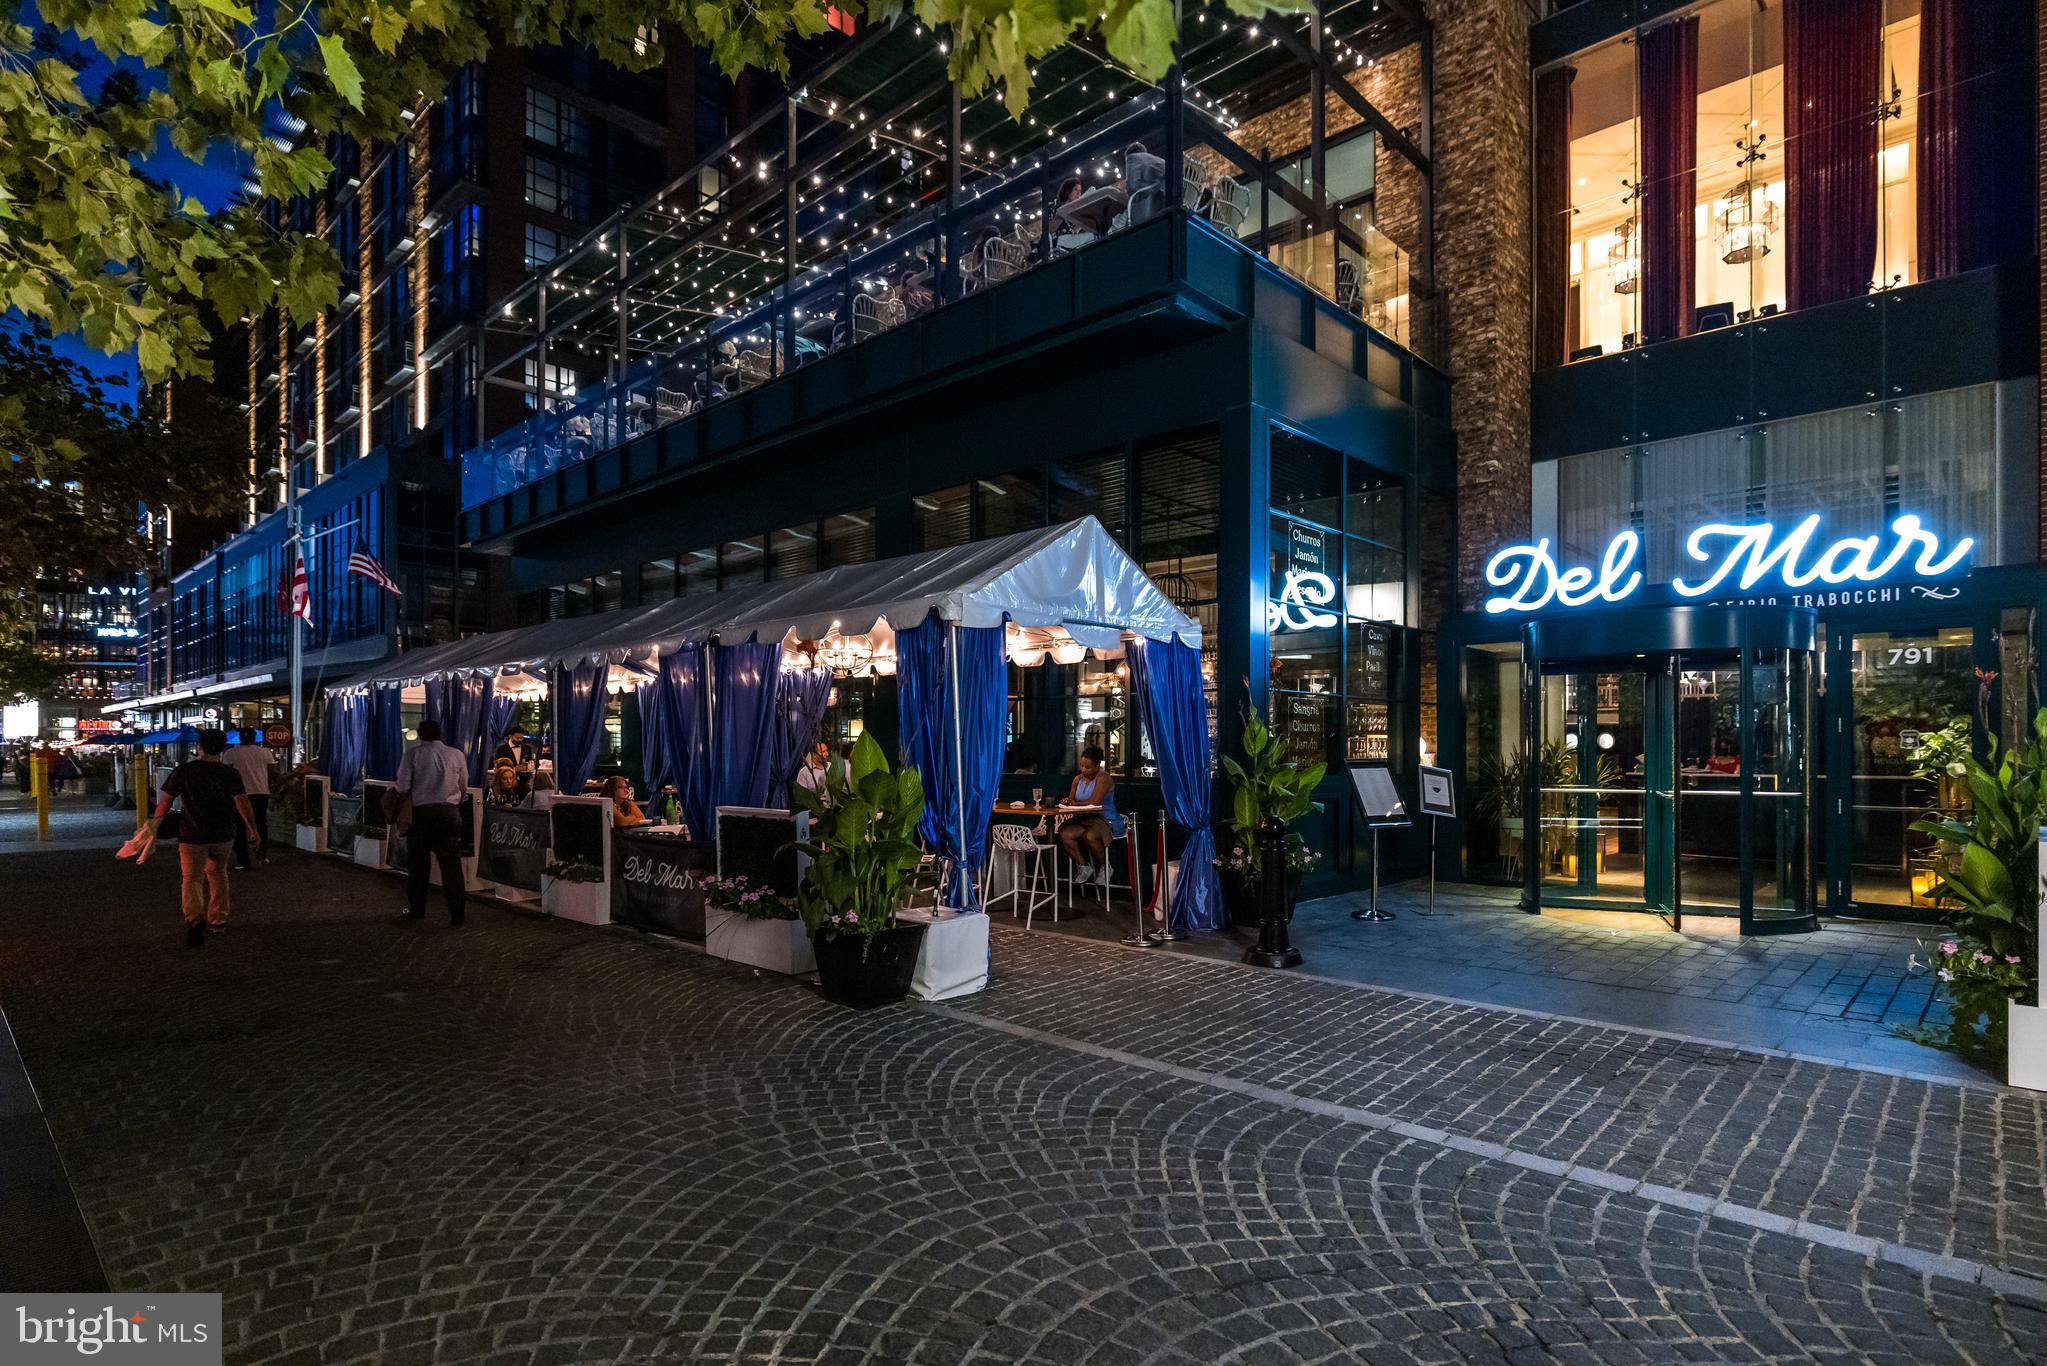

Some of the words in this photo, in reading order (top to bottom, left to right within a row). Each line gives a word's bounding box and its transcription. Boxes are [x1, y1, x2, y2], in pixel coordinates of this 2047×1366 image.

[1292, 528, 1321, 548] Churros
[1294, 547, 1319, 565] Jamón
[1484, 528, 1643, 614] Del
[1672, 513, 1975, 598] Mar
[87, 586, 112, 595] LA
[1792, 587, 1901, 608] TRABOCCHI
[1887, 647, 1934, 666] 791
[268, 730, 289, 739] STOP
[623, 856, 653, 883] Del
[654, 862, 695, 890] Mar
